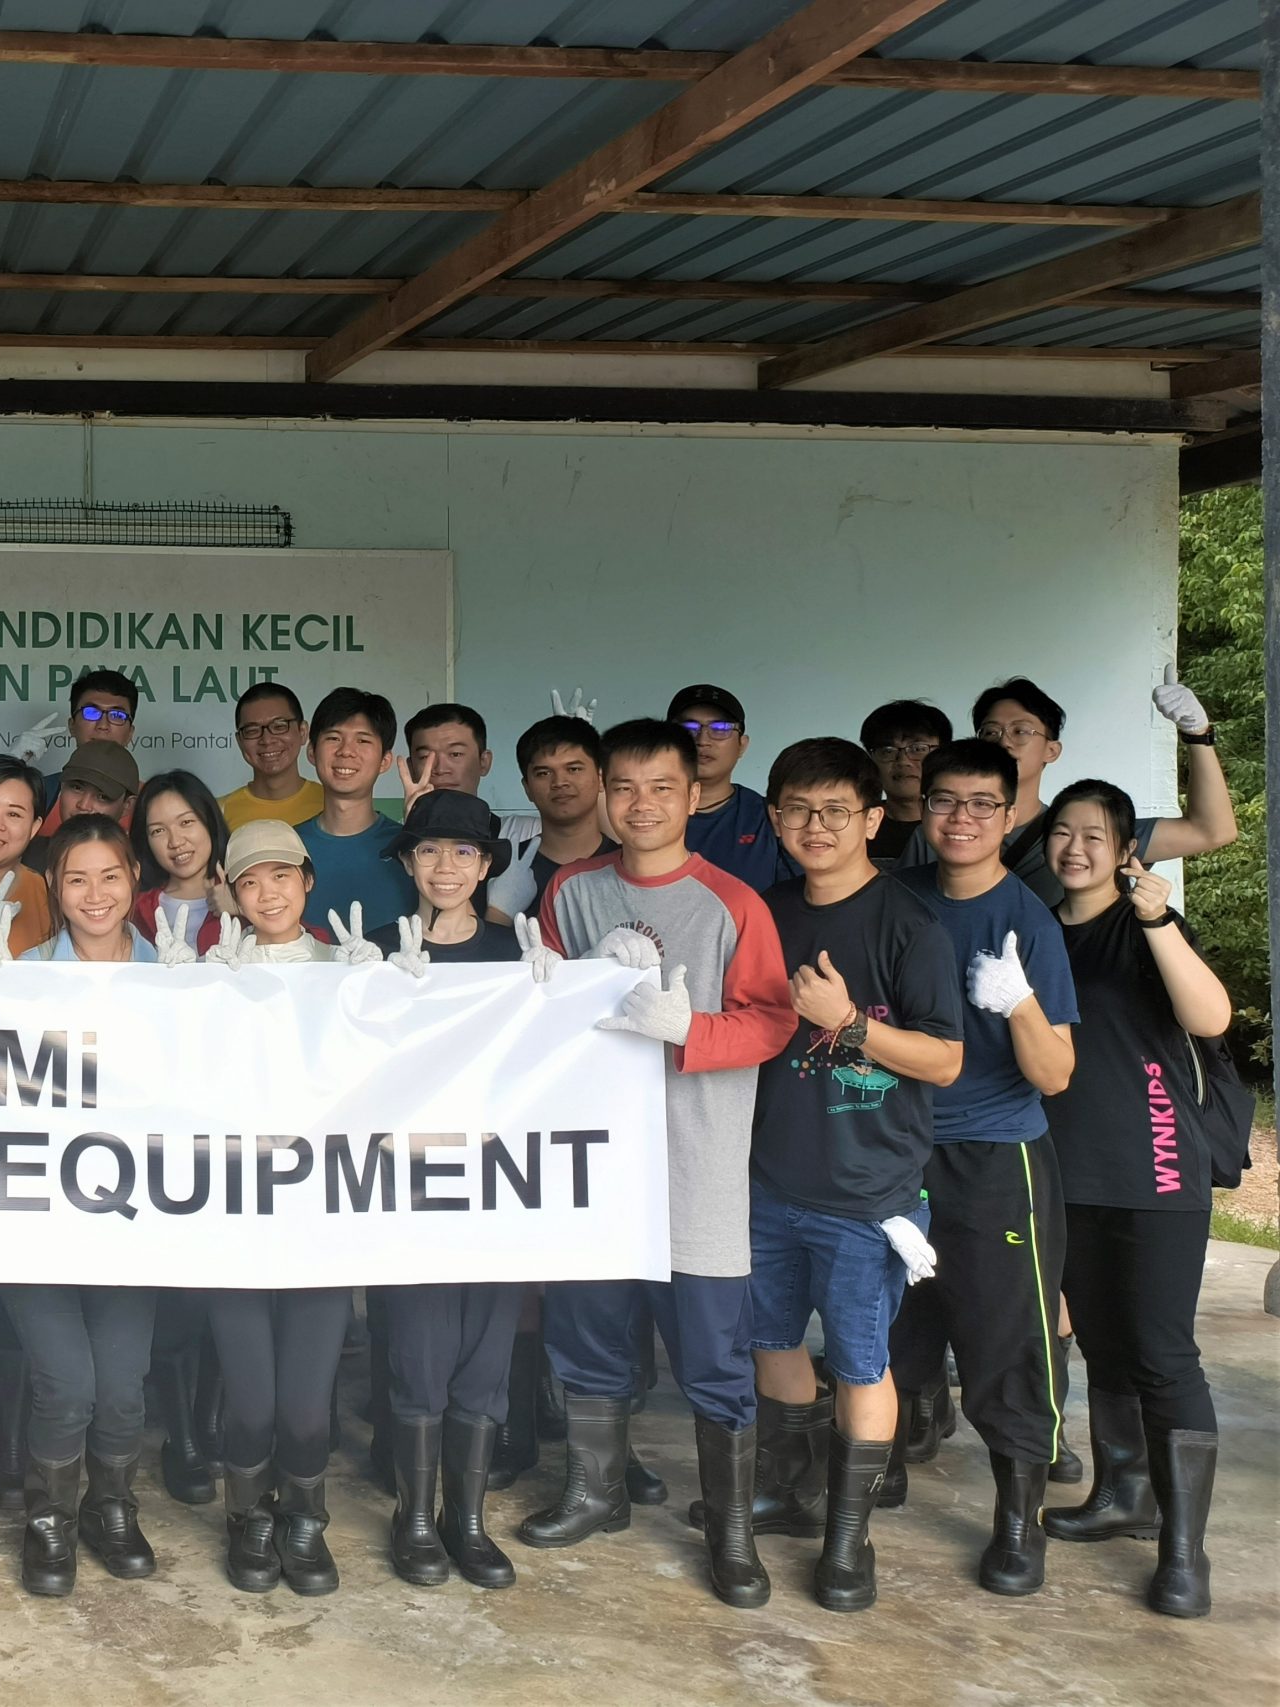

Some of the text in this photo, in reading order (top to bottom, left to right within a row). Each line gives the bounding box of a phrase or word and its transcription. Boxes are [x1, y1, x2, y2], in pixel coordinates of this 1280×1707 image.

[241, 613, 365, 653] KECIL
[170, 731, 234, 750] Pantai
[1143, 1062, 1182, 1194] WYNKIDS
